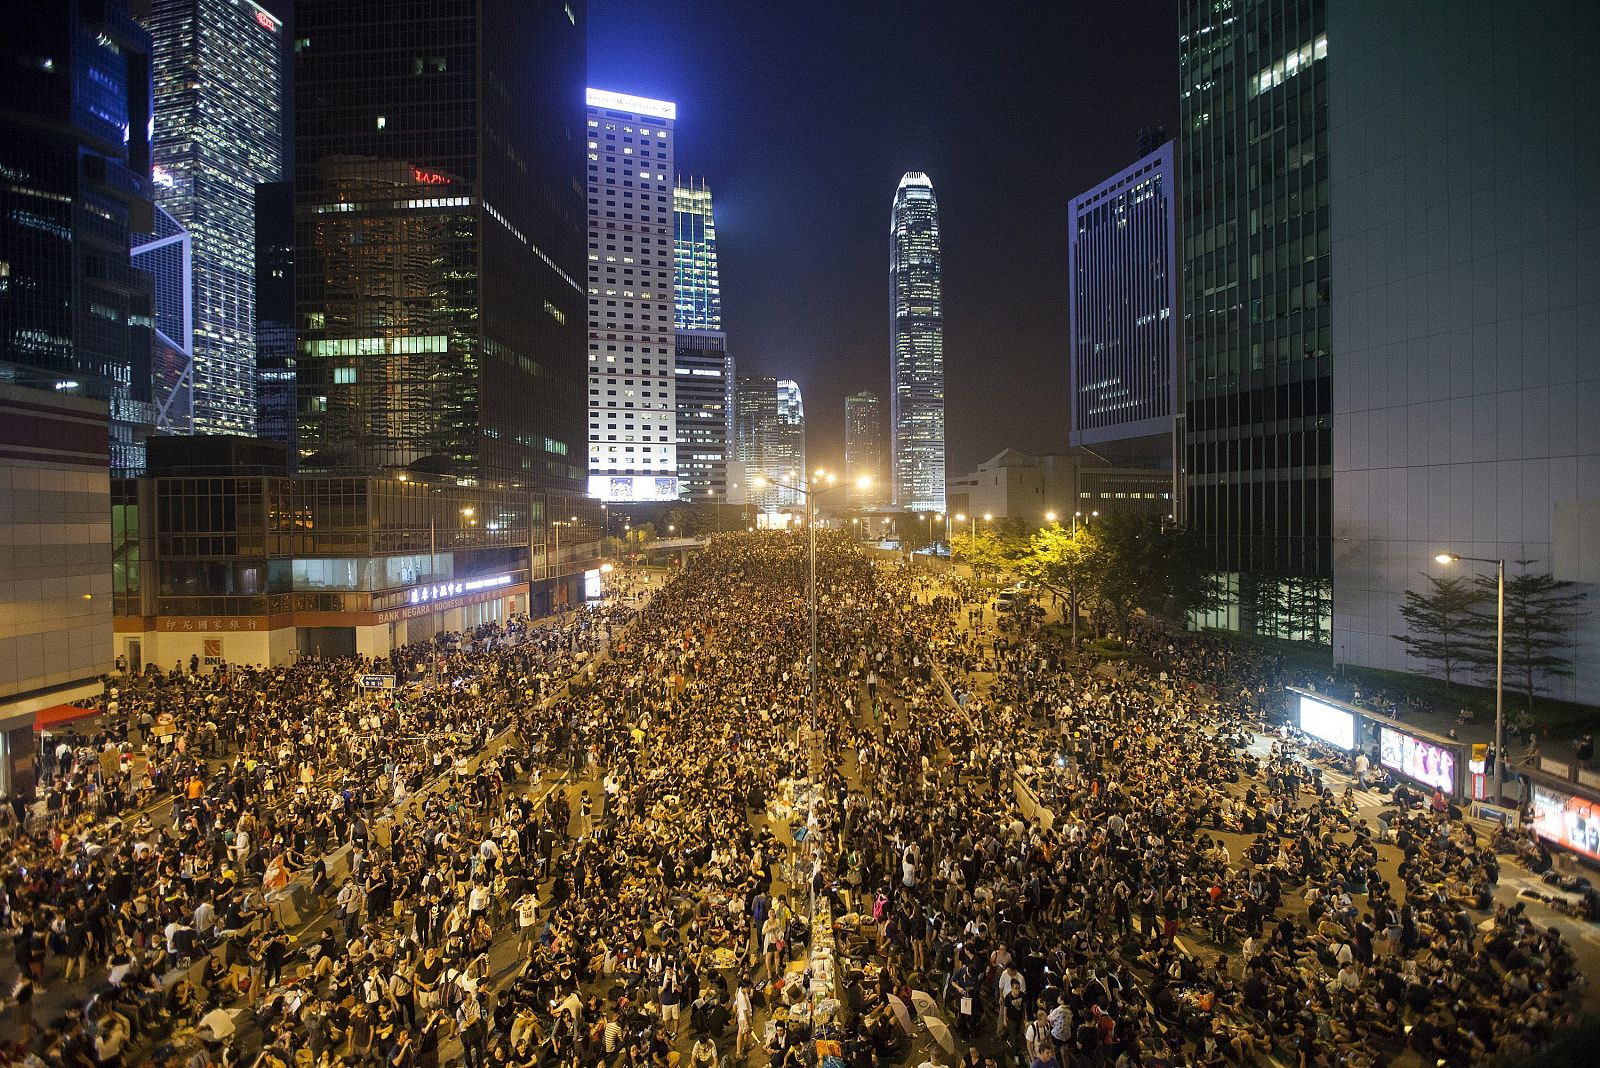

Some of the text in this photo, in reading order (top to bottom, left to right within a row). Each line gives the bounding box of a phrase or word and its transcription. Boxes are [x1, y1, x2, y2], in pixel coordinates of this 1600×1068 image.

[378, 611, 400, 623] BANK
[402, 605, 430, 619] NEGARA
[166, 618, 258, 630] 印尼國家銀行
[204, 657, 221, 665] BNI
